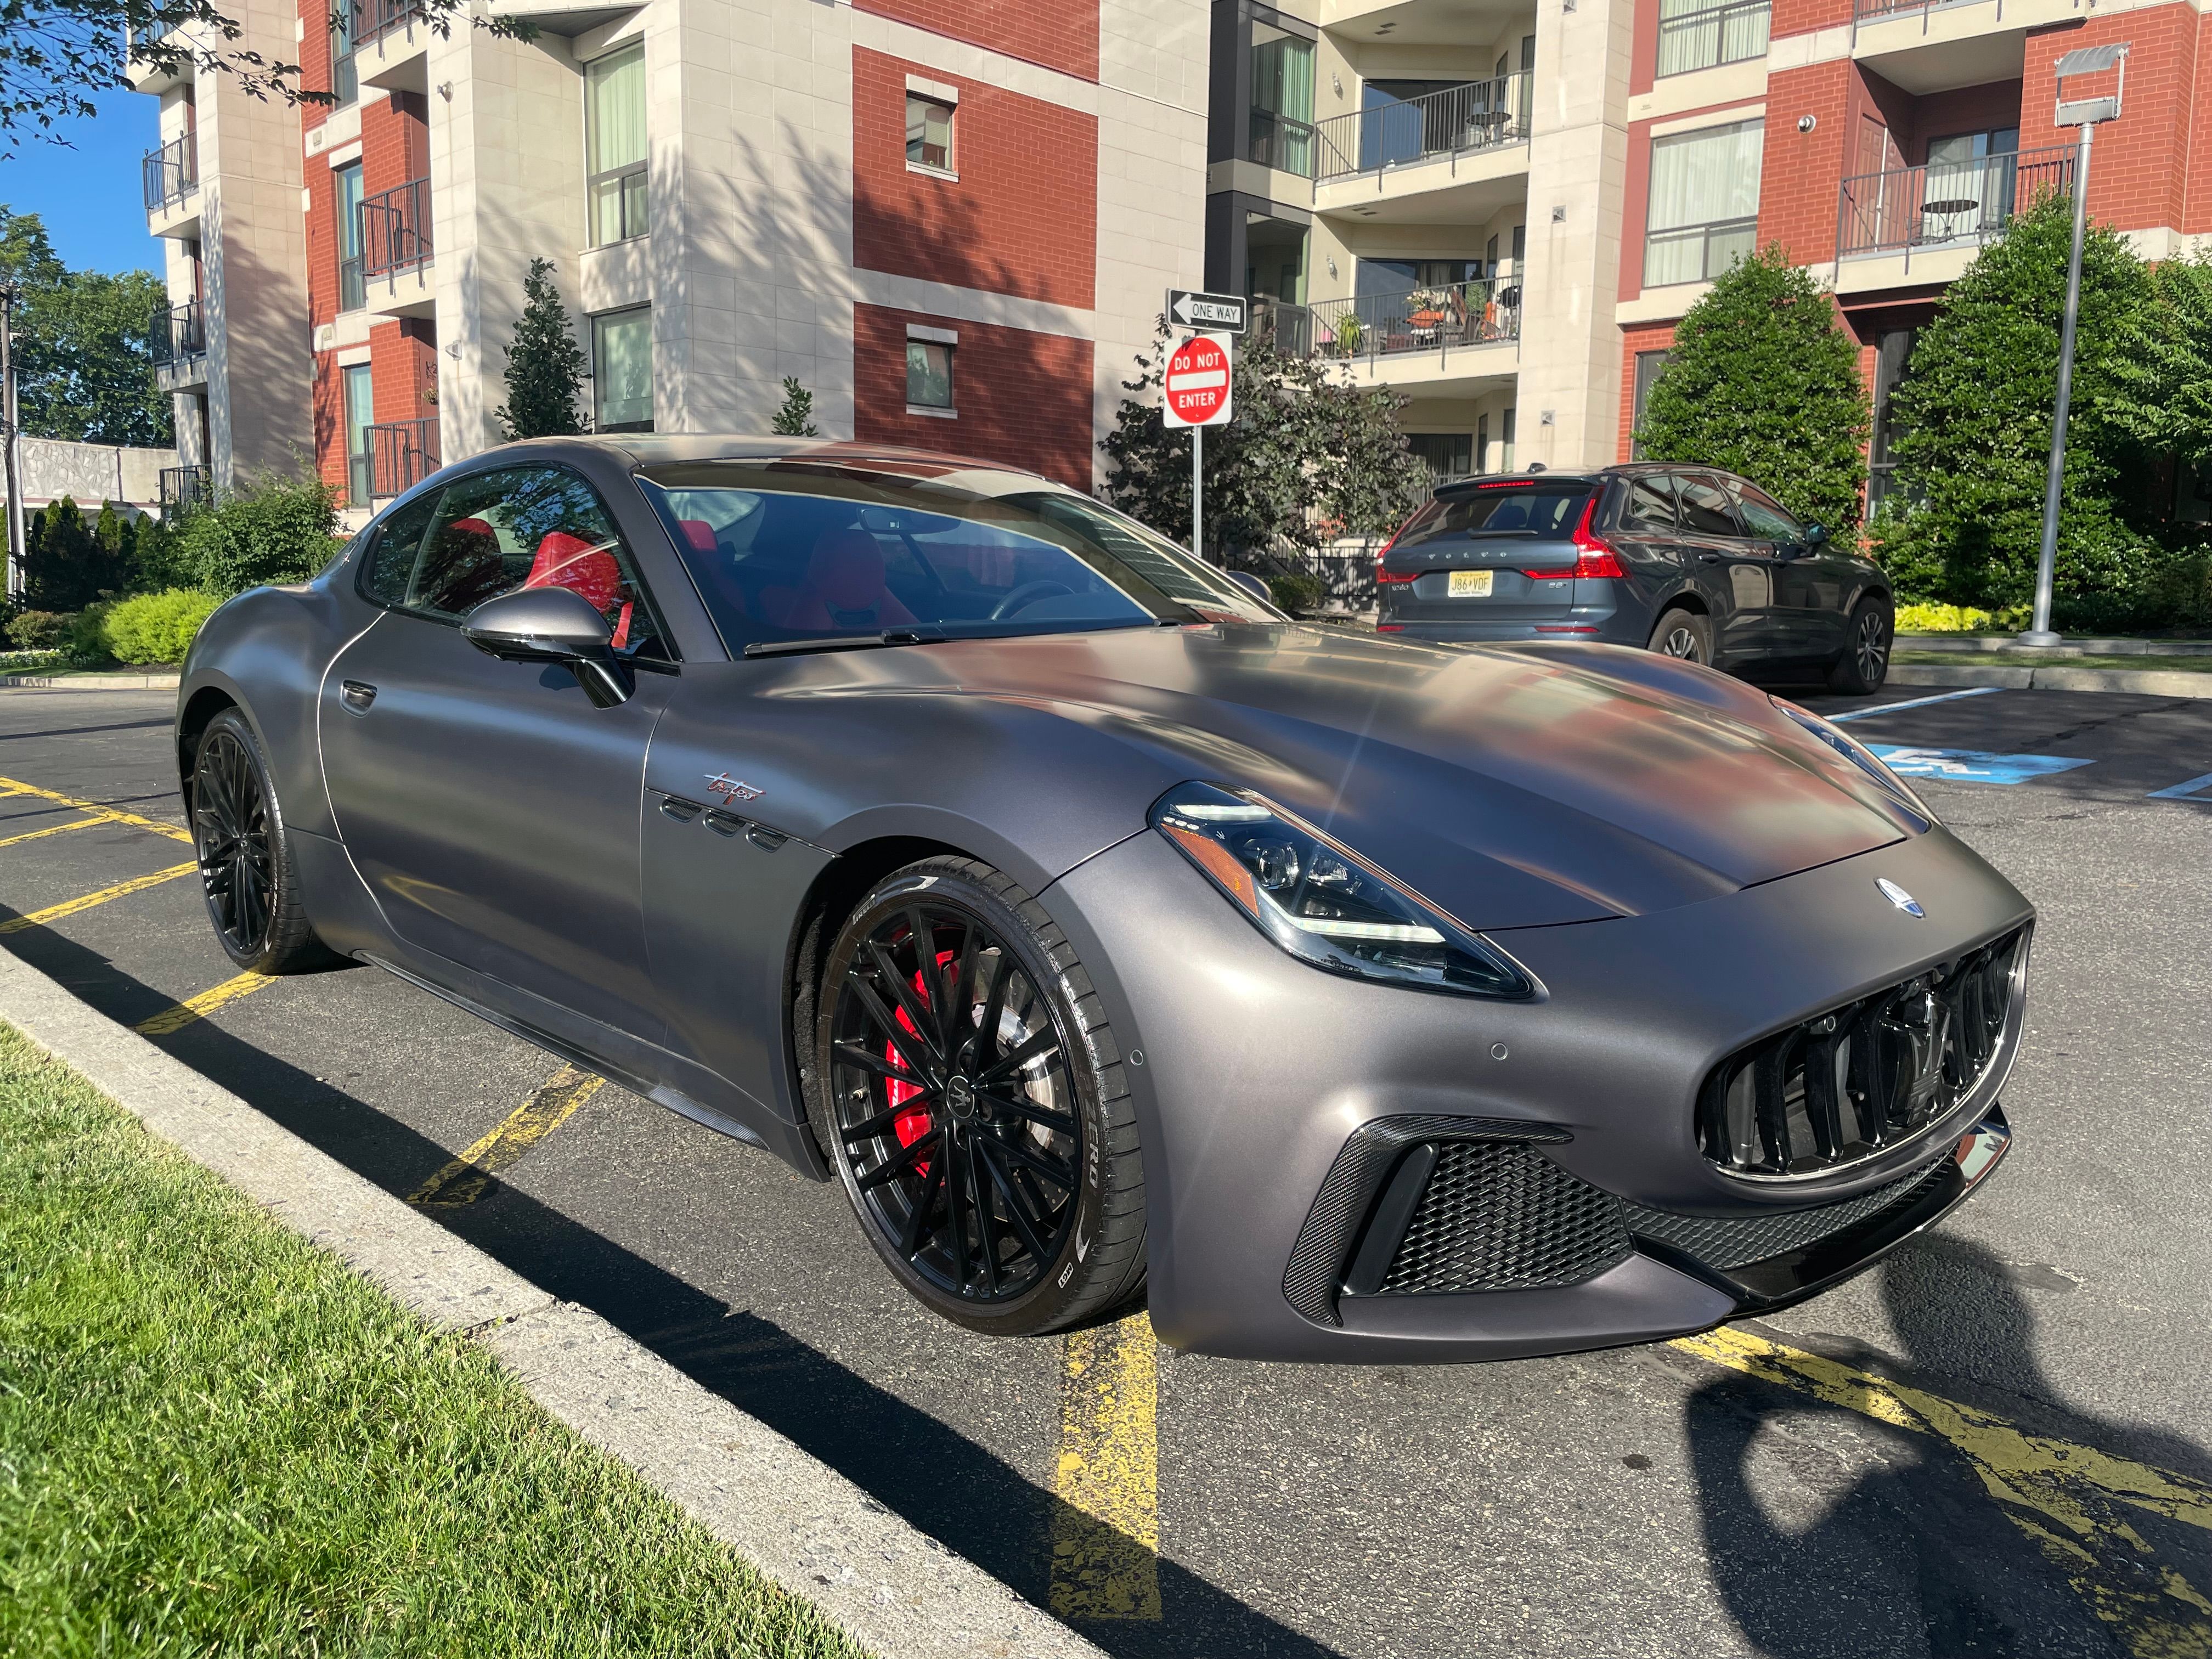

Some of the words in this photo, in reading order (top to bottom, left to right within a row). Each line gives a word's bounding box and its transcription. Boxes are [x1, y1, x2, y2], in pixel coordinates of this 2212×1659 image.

[1193, 303, 1212, 318] ONE
[1216, 307, 1237, 321] WAY
[1175, 357, 1190, 371] DO
[1197, 353, 1220, 368] NOT
[1180, 392, 1216, 408] ENTER
[1085, 1098, 1099, 1188] ZERO
